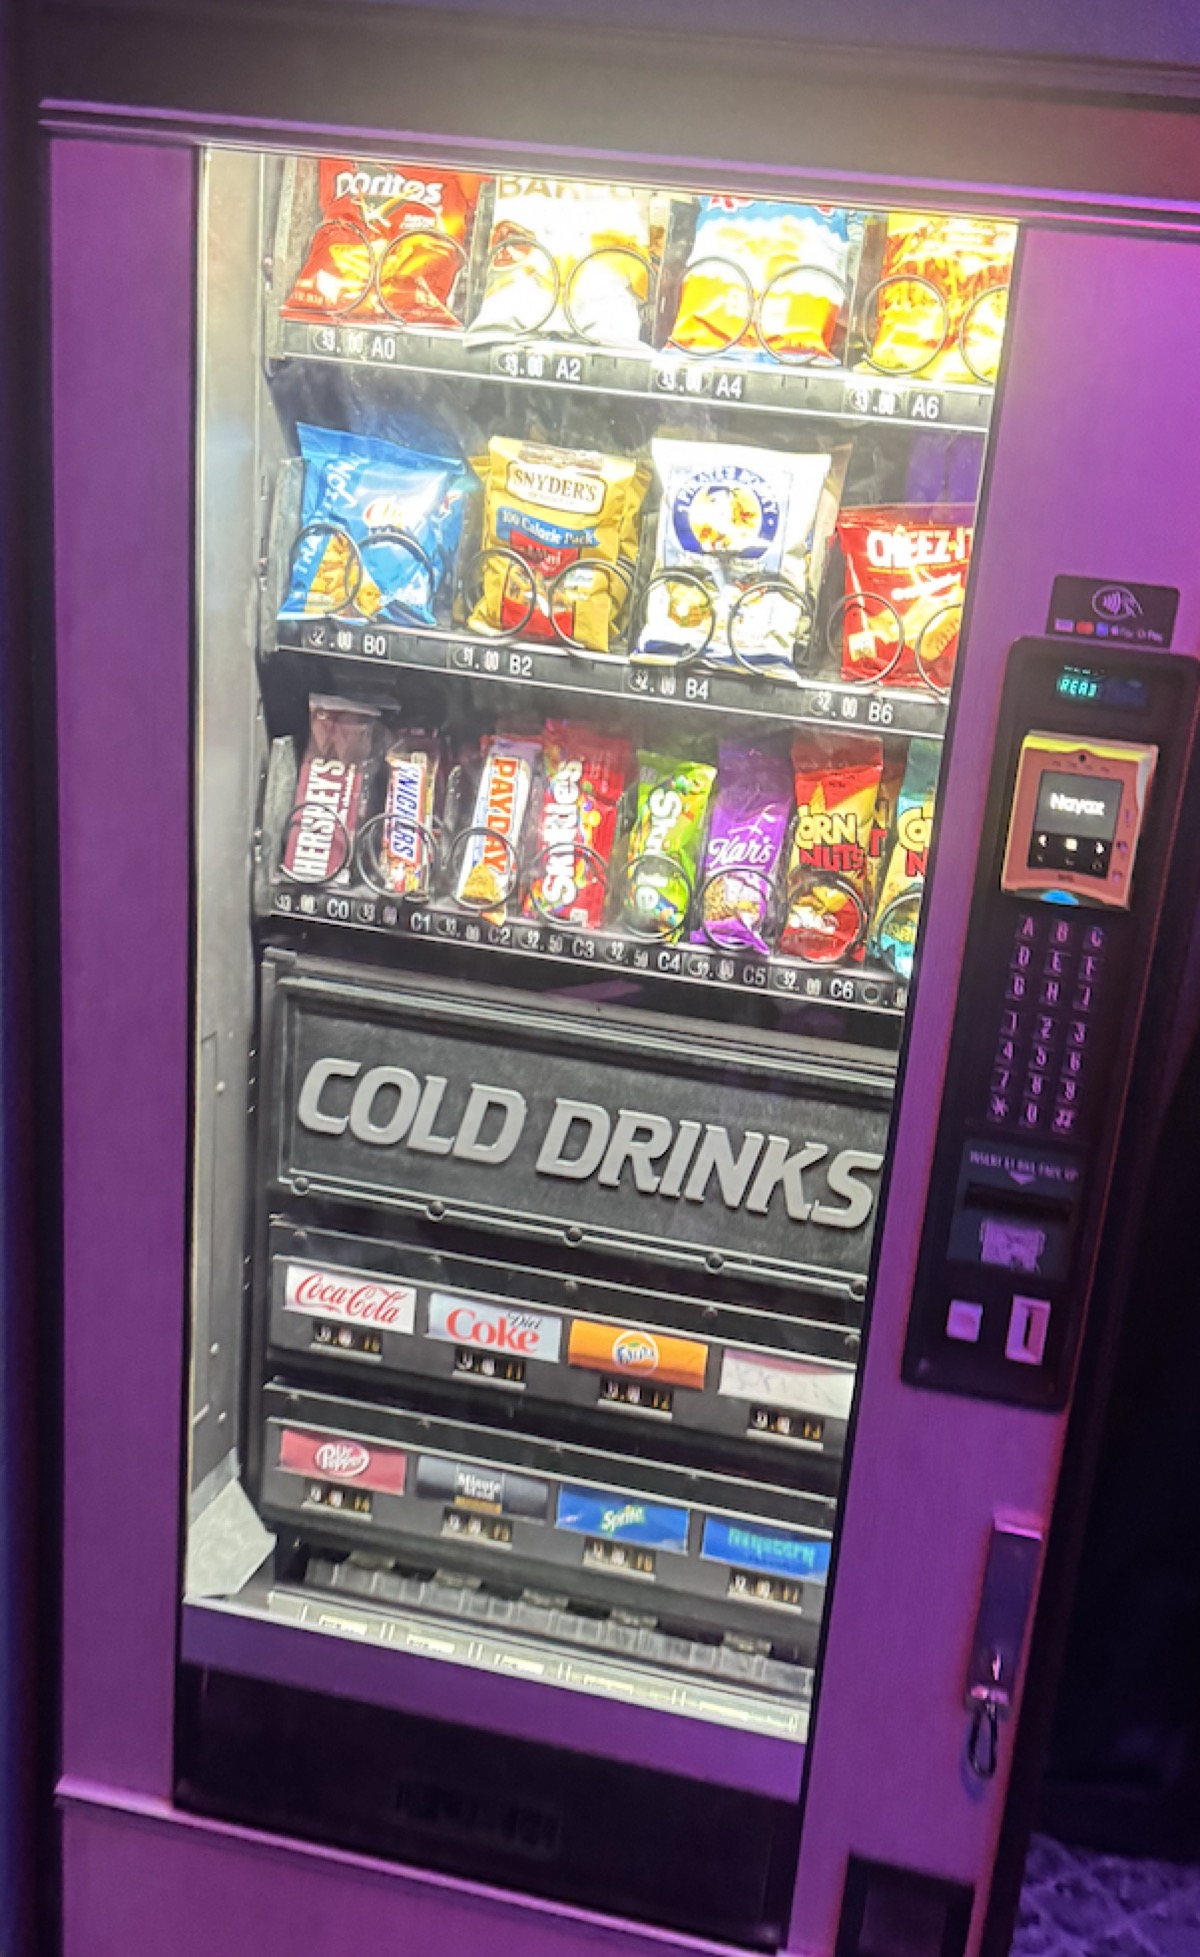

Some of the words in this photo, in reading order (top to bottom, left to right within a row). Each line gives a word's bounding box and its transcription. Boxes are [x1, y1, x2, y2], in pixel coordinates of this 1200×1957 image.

[556, 359, 581, 381] A2
[716, 376, 743, 398] A4
[912, 395, 940, 419] A6
[364, 635, 386, 655] B0
[509, 654, 532, 677] B2
[685, 679, 709, 700] B4
[869, 701, 893, 723] B6
[484, 758, 519, 873] PAYDAY
[327, 900, 348, 918] C0
[410, 909, 431, 929] C1
[488, 926, 511, 945] C2
[1023, 917, 1034, 936] A
[571, 939, 595, 957] C3
[657, 952, 681, 971] C4
[743, 967, 766, 985] C5
[830, 979, 854, 999] C6
[1073, 1023, 1085, 1044] 3
[1002, 1042, 1014, 1061] 4
[299, 1057, 526, 1165] COLD
[536, 1096, 883, 1229] DRINKS
[295, 1272, 407, 1323] Coca-Cola
[446, 1307, 540, 1354] Coke
